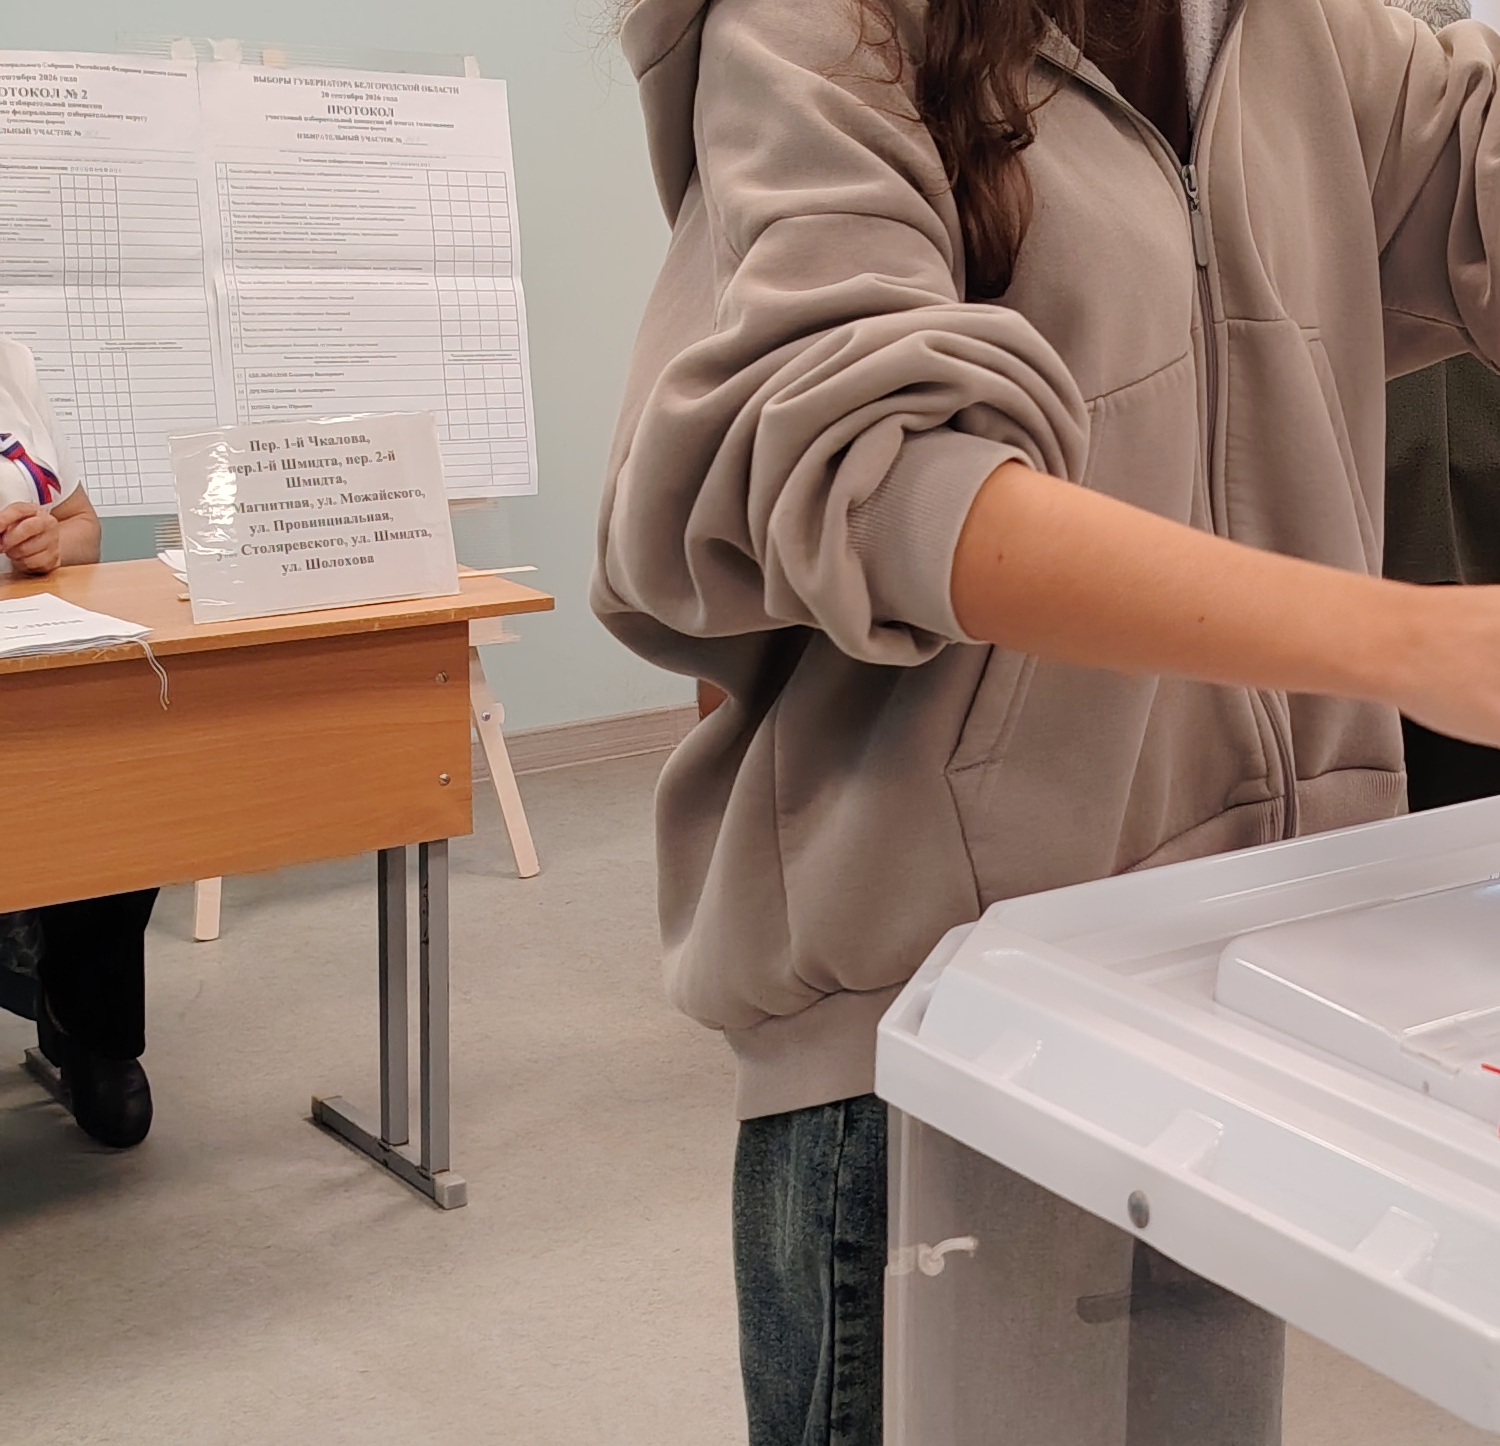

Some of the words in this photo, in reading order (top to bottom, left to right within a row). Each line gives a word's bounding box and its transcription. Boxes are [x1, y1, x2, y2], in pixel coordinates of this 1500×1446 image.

[81, 89, 89, 100] 2
[327, 105, 395, 117] ПРОТОКОЛ
[250, 440, 281, 453] Пер.
[284, 437, 305, 450] 1-й
[309, 433, 371, 447] Чкалова,
[281, 456, 342, 471] Шмидта,
[346, 455, 373, 466] пер.
[375, 450, 396, 462] 2-й
[286, 475, 347, 488] Шмидта,
[233, 498, 315, 514] Магнитная,
[317, 497, 337, 509] ул.
[339, 488, 426, 505] Можайского,
[249, 523, 270, 537] ул.
[273, 513, 394, 532] Провинциальная,
[351, 535, 371, 548] ул.
[374, 527, 432, 542] Шмидта,
[281, 563, 302, 576] ул.
[305, 555, 375, 570] Шолохова
